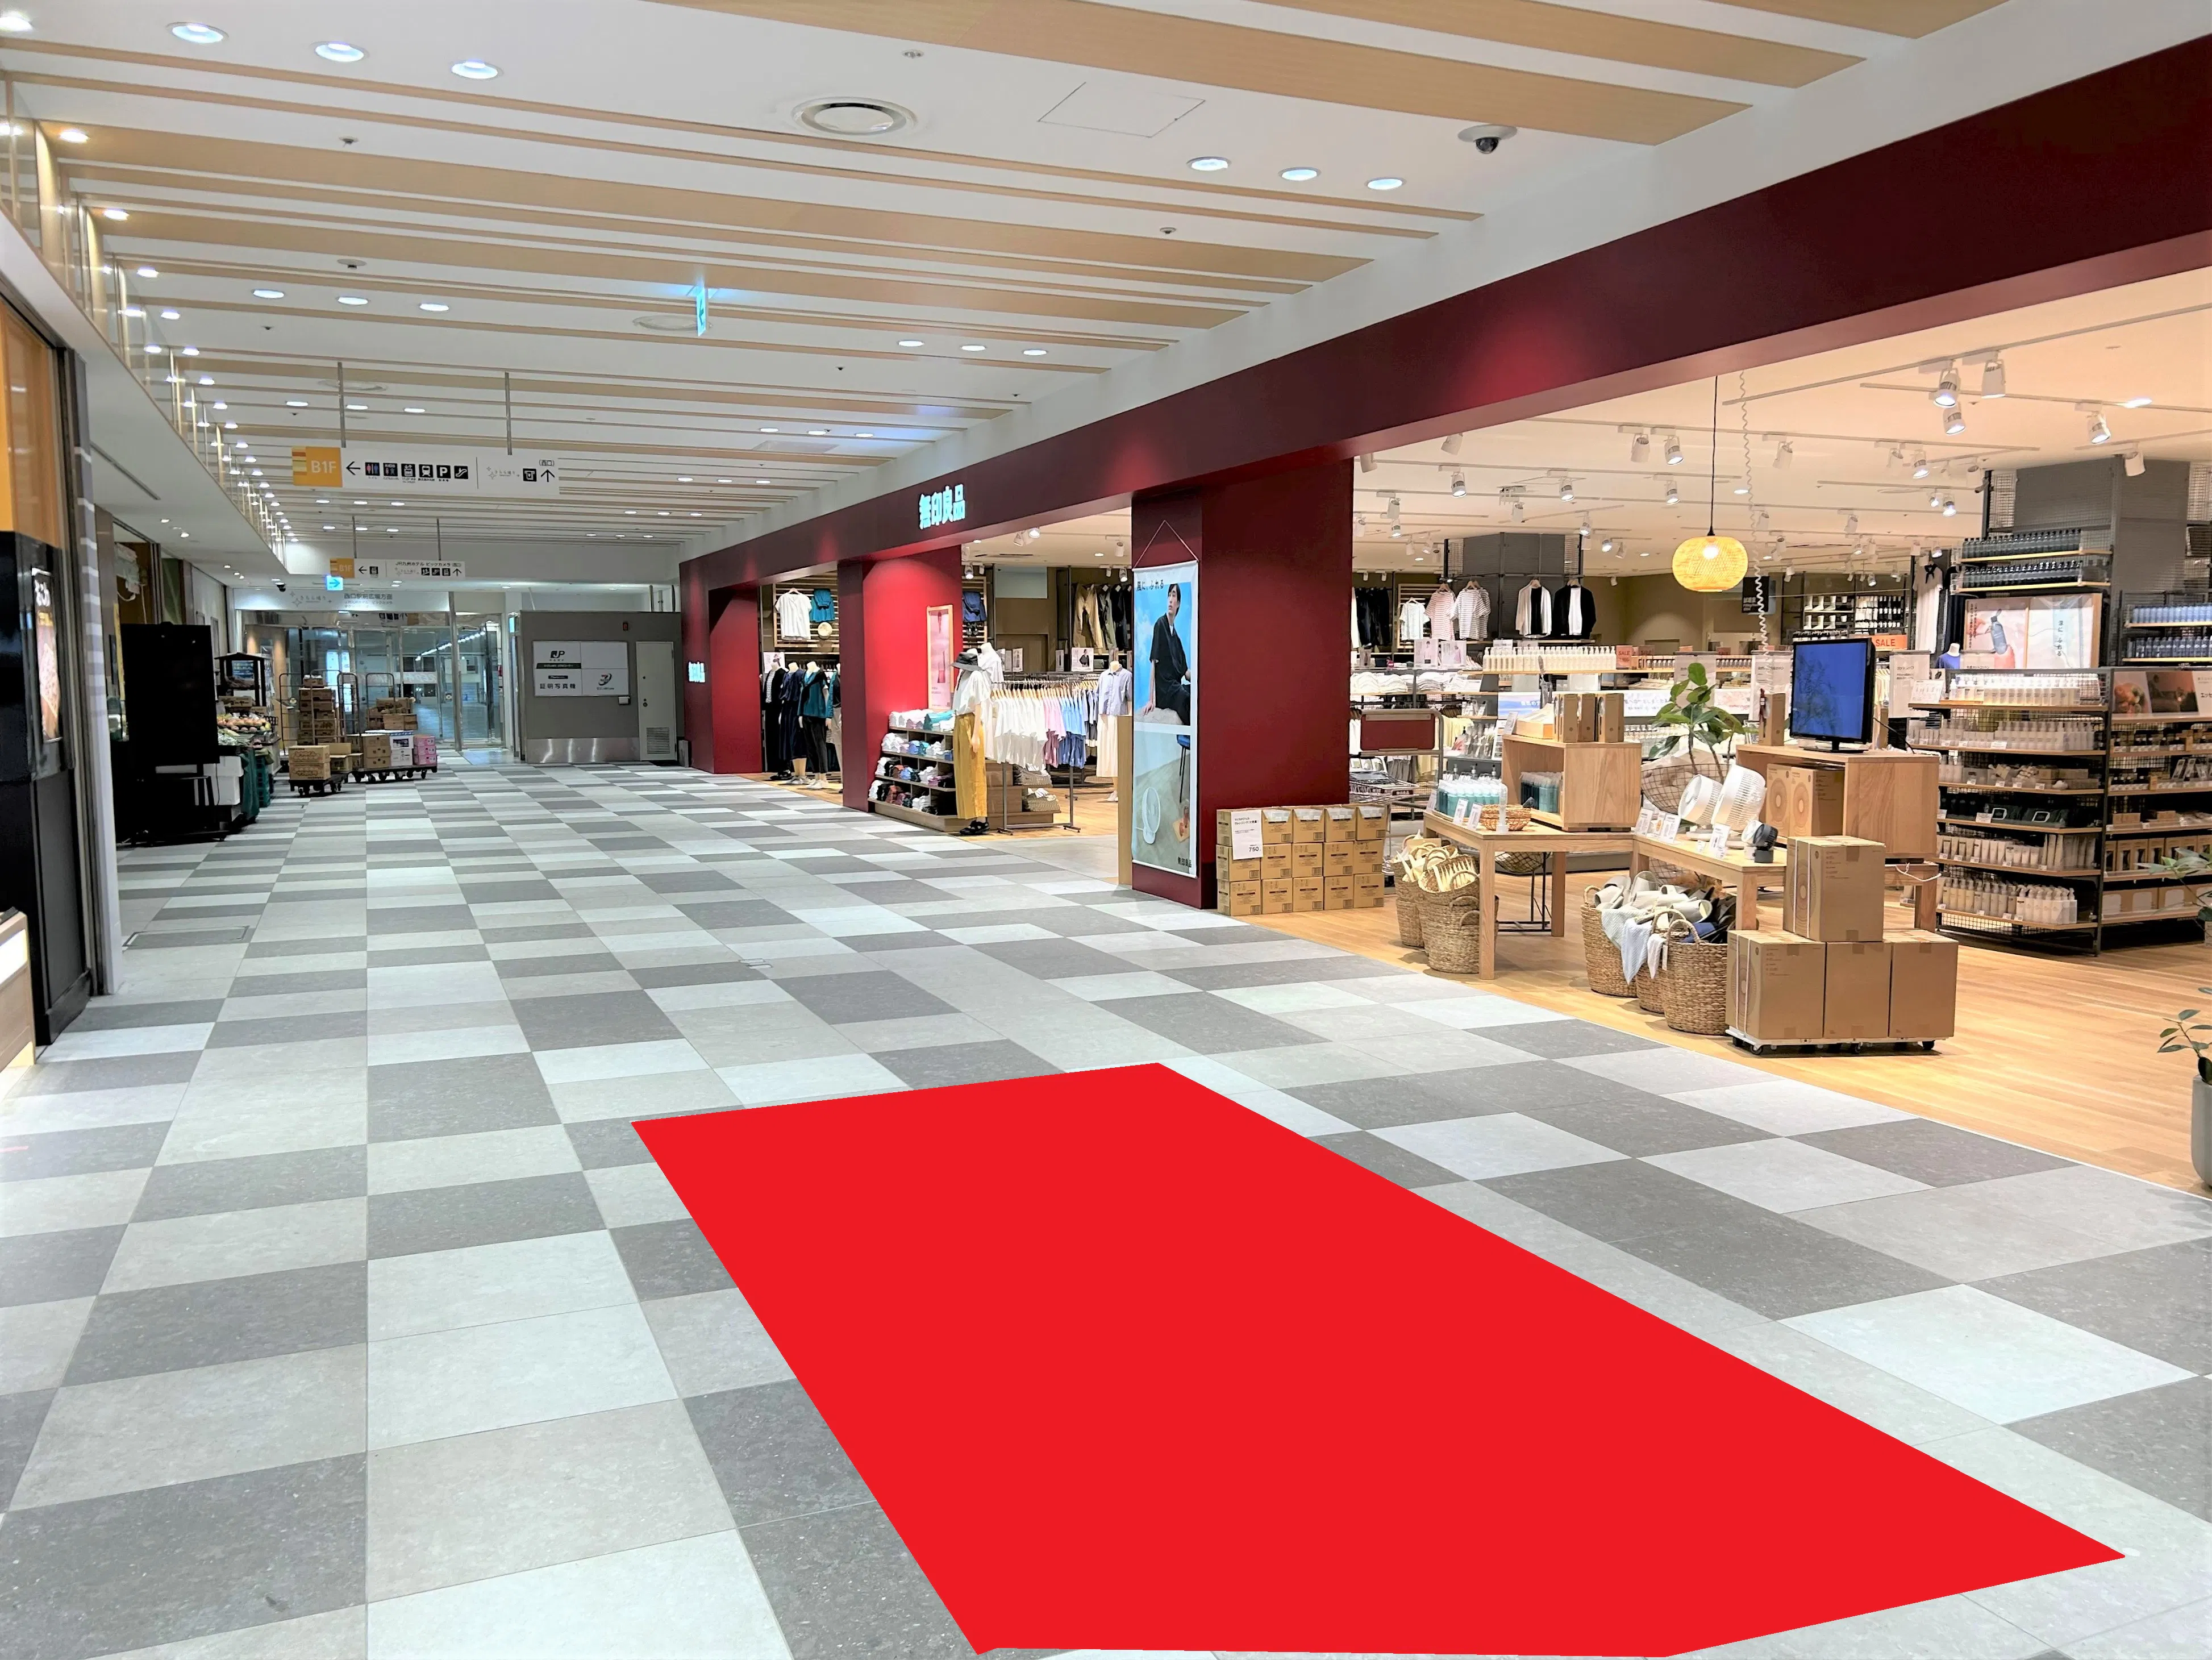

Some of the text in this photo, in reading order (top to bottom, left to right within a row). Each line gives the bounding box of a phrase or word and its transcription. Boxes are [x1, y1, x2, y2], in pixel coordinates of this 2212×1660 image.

[311, 460, 336, 473] B1F
[919, 484, 965, 529] 無印良品
